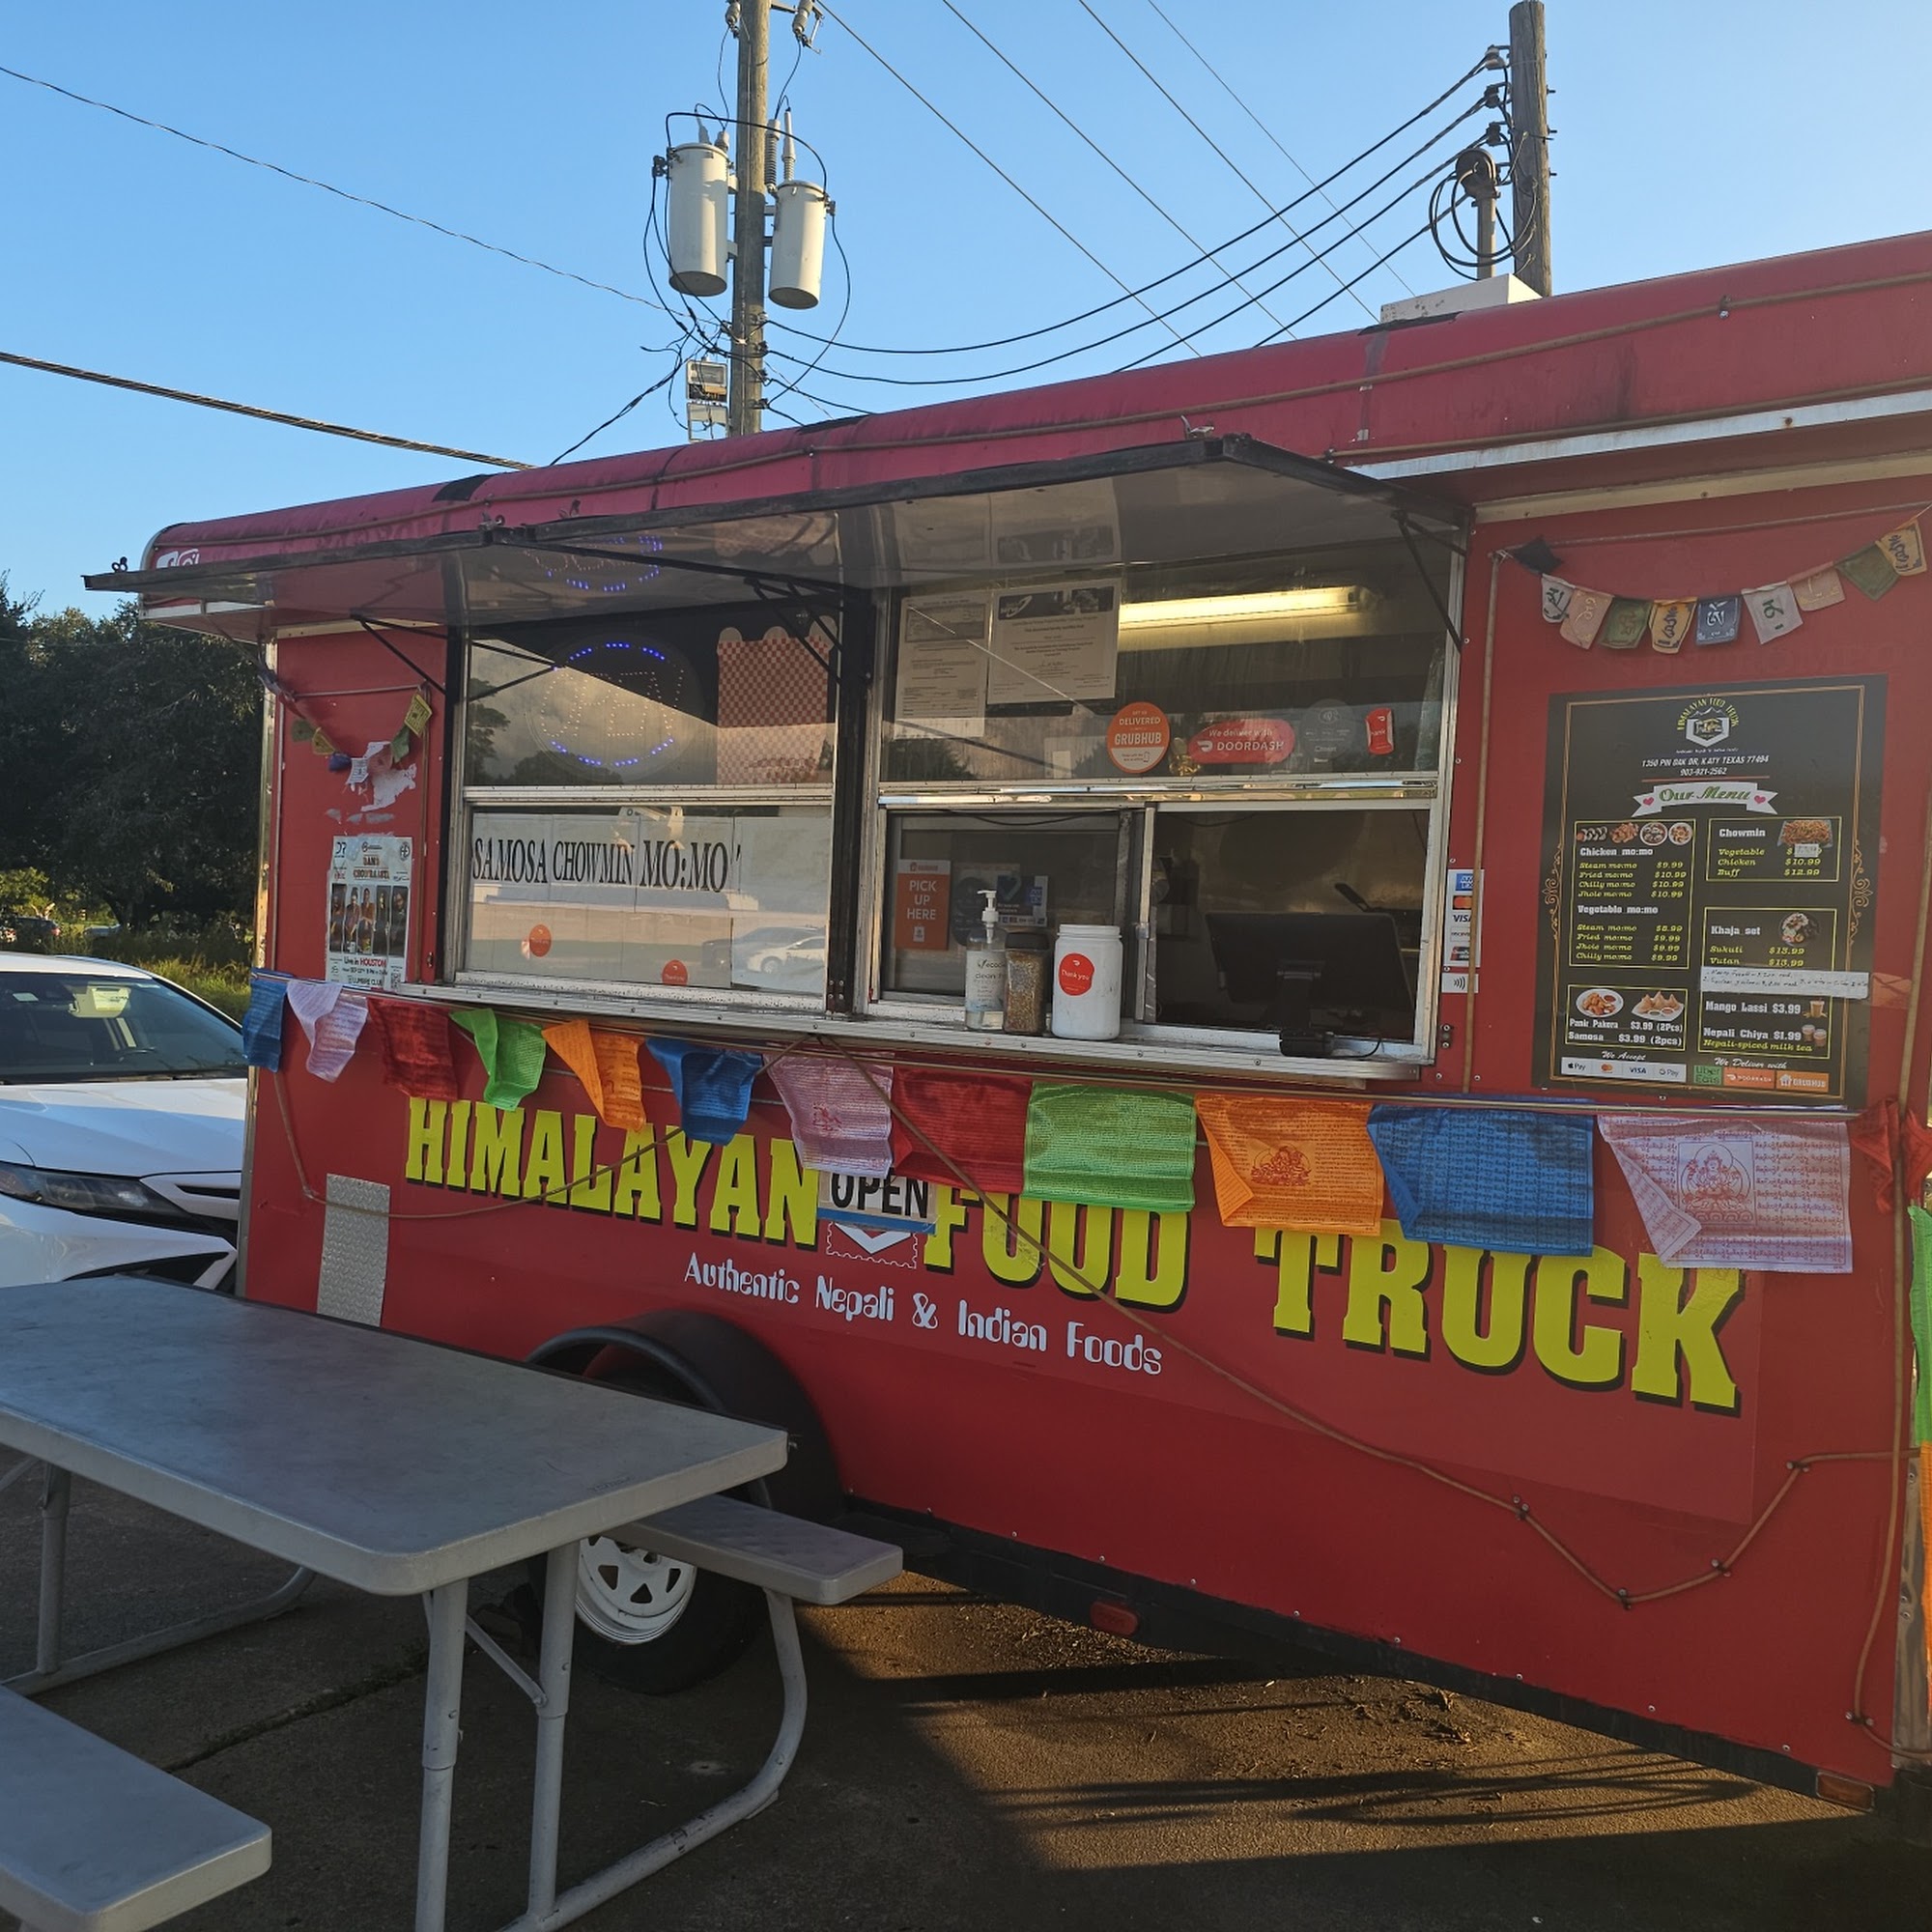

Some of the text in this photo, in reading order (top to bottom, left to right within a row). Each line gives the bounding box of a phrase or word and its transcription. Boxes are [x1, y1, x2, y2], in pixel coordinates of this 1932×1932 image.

[1119, 717, 1161, 725] DELIVERED
[1114, 732, 1162, 745] GRUBHUB
[1216, 740, 1285, 752] DOORDASH
[1722, 755, 1745, 765] TEXAS
[1659, 785, 1751, 803] Our Menu
[1719, 828, 1766, 838] Chowmin
[1579, 847, 1617, 856] Chicken
[1718, 848, 1765, 858] Vegetable
[472, 838, 727, 894] SAMOSA CHOWMIN MO:MO
[1656, 861, 1684, 869] $9.99
[1717, 858, 1822, 867] Chicken $10.99
[1717, 868, 1741, 878] Buff
[909, 879, 937, 893] PICK
[1577, 881, 1605, 890] Chilly
[1652, 880, 1685, 889] $10.99
[914, 894, 931, 905] UP
[1650, 890, 1683, 898] $10.99
[906, 908, 937, 921] HERE
[1577, 904, 1659, 916] Vegetable mo:mo
[1577, 923, 1605, 932] Steam
[1711, 925, 1761, 937] Khaja set
[1709, 945, 1744, 954] Sukuti
[1576, 952, 1603, 961] Chilly
[1650, 953, 1678, 962] $9.99
[1061, 969, 1078, 979] Thank
[1705, 1000, 1802, 1014] Mango Lassi $3.99
[1630, 1021, 1654, 1031] $3.99
[1657, 1022, 1684, 1033] (2Pcs)
[1568, 1031, 1683, 1046] Samosa $3.99 (2pcs)
[1703, 1027, 1803, 1041] Nepali Chiya $1.99
[1703, 1039, 1769, 1050] Nepali-spiced
[1601, 1050, 1647, 1062] We Accept
[1714, 1057, 1788, 1069] We Deliver with
[831, 1167, 929, 1219] OPEN
[406, 1097, 819, 1249] HIMALAYAN
[1255, 1219, 1741, 1413] TRUCK
[684, 1252, 1163, 1376] Authentic Nepali & Indian Foods
